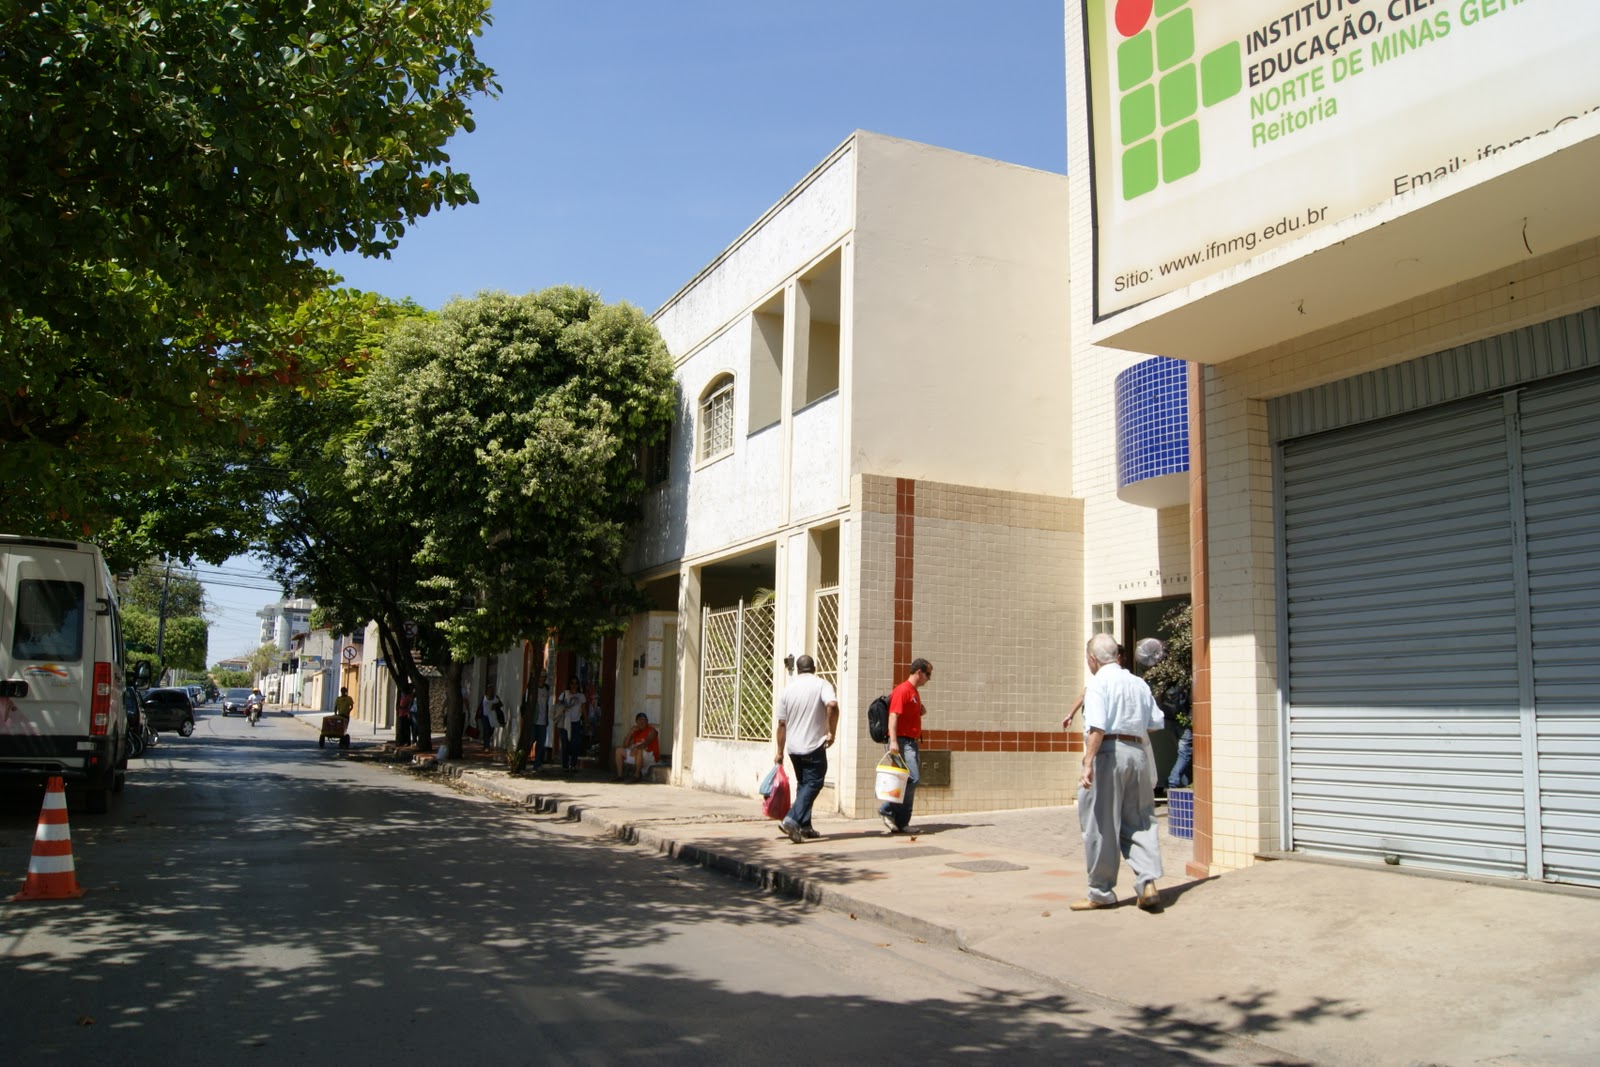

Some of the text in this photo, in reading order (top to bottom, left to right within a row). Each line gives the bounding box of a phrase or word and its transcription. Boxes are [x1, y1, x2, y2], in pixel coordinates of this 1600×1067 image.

[1246, 0, 1361, 55] INSTITU
[1248, 0, 1435, 88] EDUCAÇÃO, CI
[1250, 0, 1524, 120] NORTE DE MINAS GE
[1251, 96, 1338, 148] Reitoria
[1114, 206, 1328, 292] Sitio: www.ifnmg.edu.br
